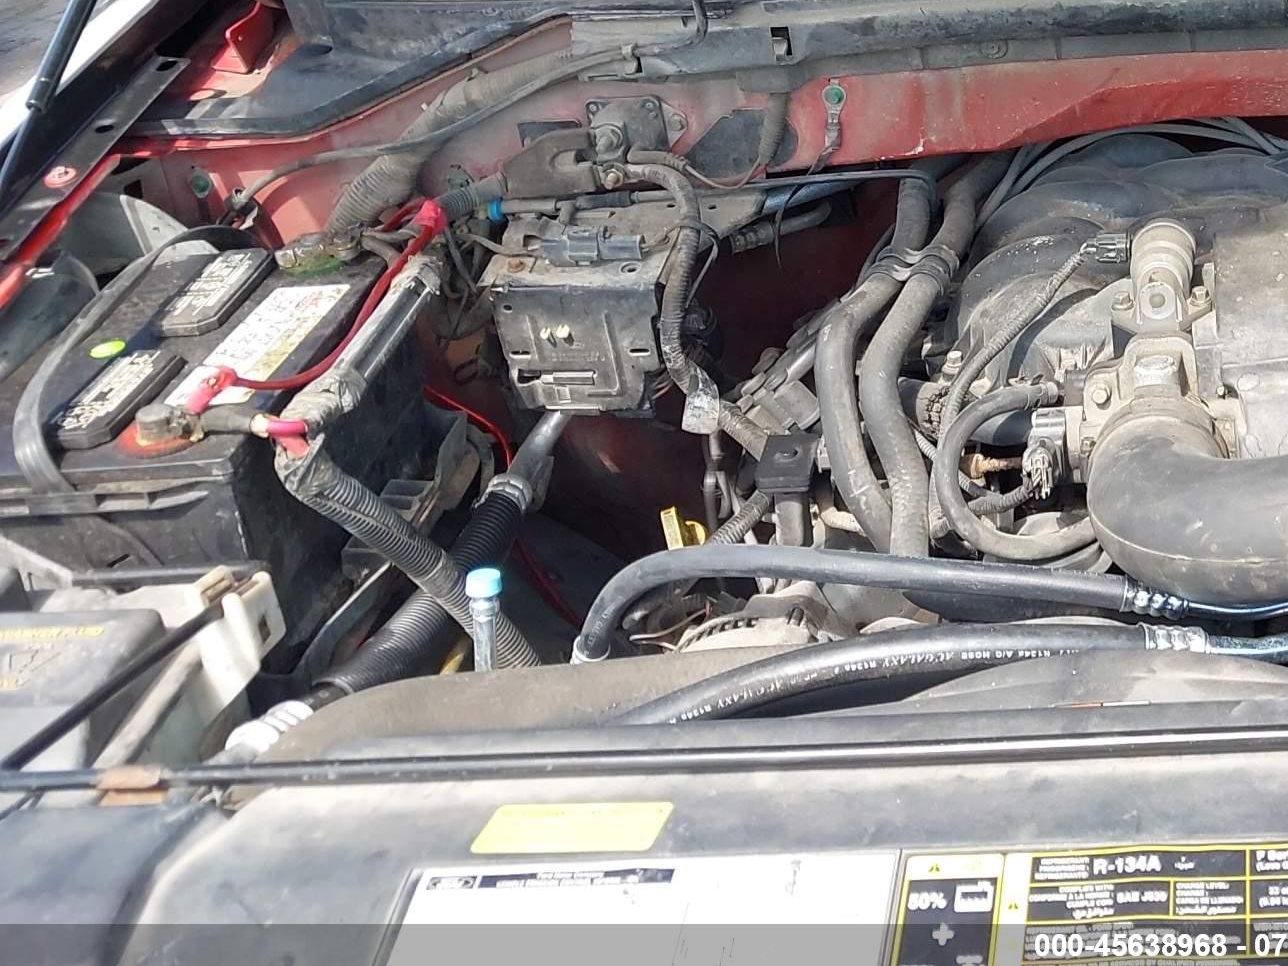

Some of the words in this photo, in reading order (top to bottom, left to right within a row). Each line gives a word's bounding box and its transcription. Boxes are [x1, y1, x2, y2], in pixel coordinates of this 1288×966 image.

[844, 660, 876, 672] R134a
[1092, 854, 1162, 876] R-134A
[1116, 890, 1140, 904] SAE
